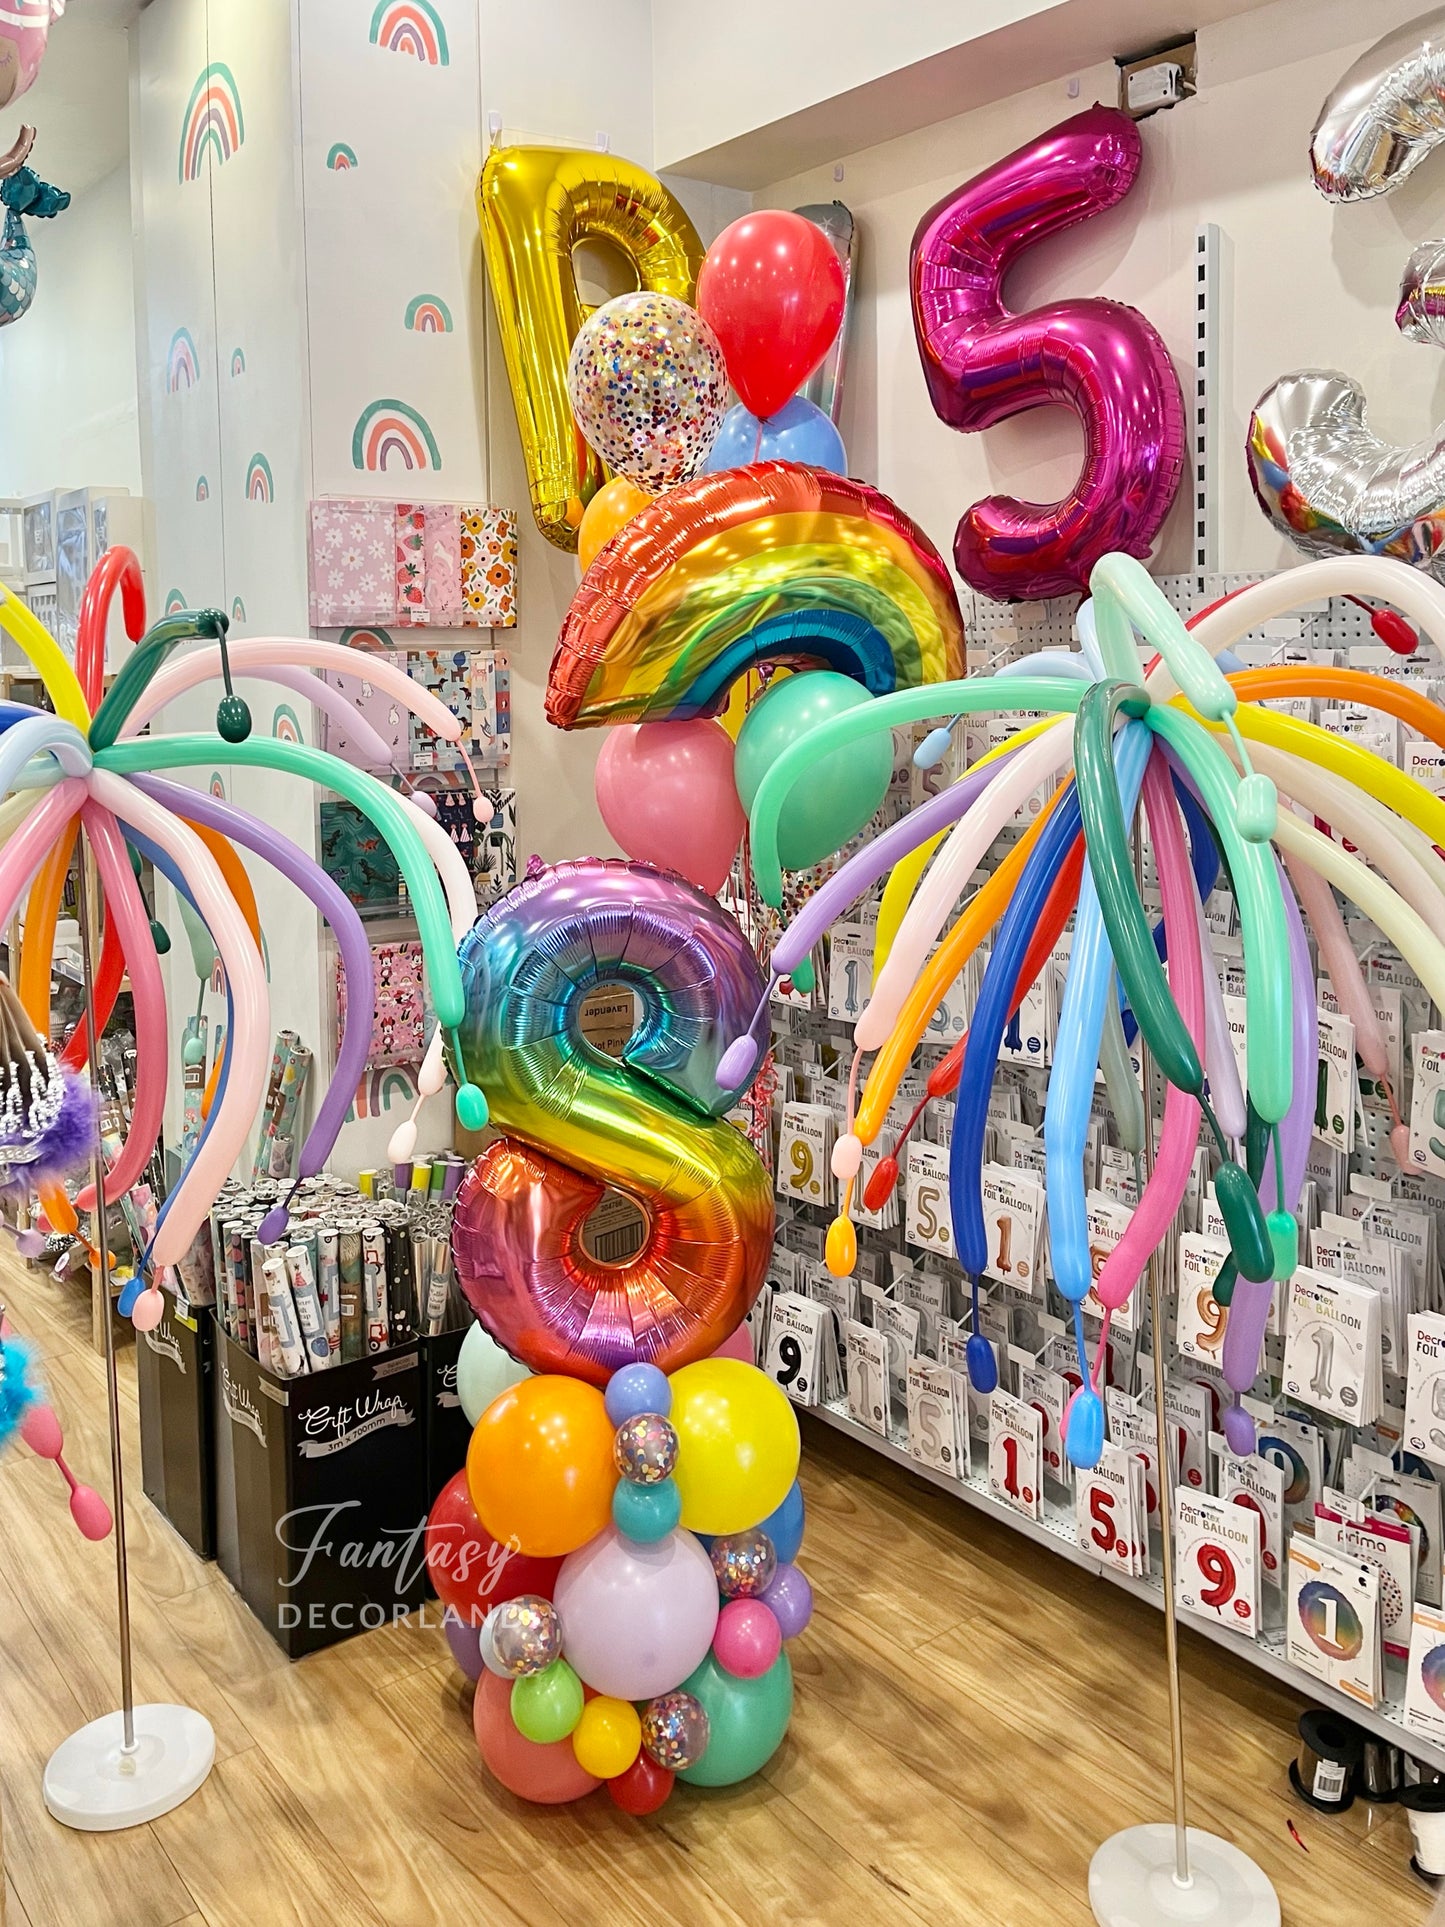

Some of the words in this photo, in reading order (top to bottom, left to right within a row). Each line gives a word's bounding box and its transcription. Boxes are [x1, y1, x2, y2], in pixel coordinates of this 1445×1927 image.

[1412, 756, 1445, 766] Decro
[1411, 768, 1435, 777] FOIL
[833, 944, 845, 952] FOIL
[585, 1005, 628, 1016] Lavender
[608, 1039, 625, 1048] Pink
[1421, 1059, 1440, 1073] FOIL
[784, 1120, 795, 1130] FOIL
[796, 1125, 823, 1138] BALLOON
[909, 1163, 920, 1174] FOIL
[984, 1188, 997, 1201] FOIL
[1000, 1193, 1032, 1213] BALLOON
[916, 1186, 940, 1242] 5
[1088, 1215, 1109, 1227] crotex
[1208, 1224, 1225, 1237] FOIL
[1375, 1224, 1422, 1246] BALLOON
[1184, 1259, 1200, 1272] FOIL
[1185, 1250, 1220, 1268] Decrotex
[1317, 1256, 1335, 1268] FOIL
[1295, 1284, 1334, 1306] Decrotex
[1293, 1294, 1311, 1311] FOIL
[1316, 1303, 1361, 1330] BALLOON
[773, 1313, 784, 1324] FOIL
[786, 1318, 813, 1335] BALLOON
[1417, 1330, 1445, 1348] Decro
[1416, 1343, 1438, 1358] FOIL
[776, 1335, 801, 1391] 9
[1310, 1326, 1334, 1400] 1
[909, 1377, 920, 1388] FOIL
[922, 1381, 949, 1398] BALLOON
[298, 1406, 353, 1438] Gift
[356, 1389, 407, 1418] Wrap
[328, 1441, 344, 1451] 3m
[353, 1416, 386, 1438] 700mm
[991, 1409, 1003, 1423] FOIL
[1006, 1417, 1034, 1442] BALLOON
[1129, 1430, 1157, 1447] BALLOO
[1003, 1437, 1019, 1500] 1
[1093, 1465, 1125, 1485] BALLOON
[1240, 1471, 1277, 1503] BALLOON
[1090, 1487, 1116, 1553] 5
[1181, 1502, 1220, 1523] Decrotex
[1180, 1511, 1198, 1526] FOIL
[1203, 1519, 1248, 1545] BALLOON
[1197, 1543, 1236, 1616] 9
